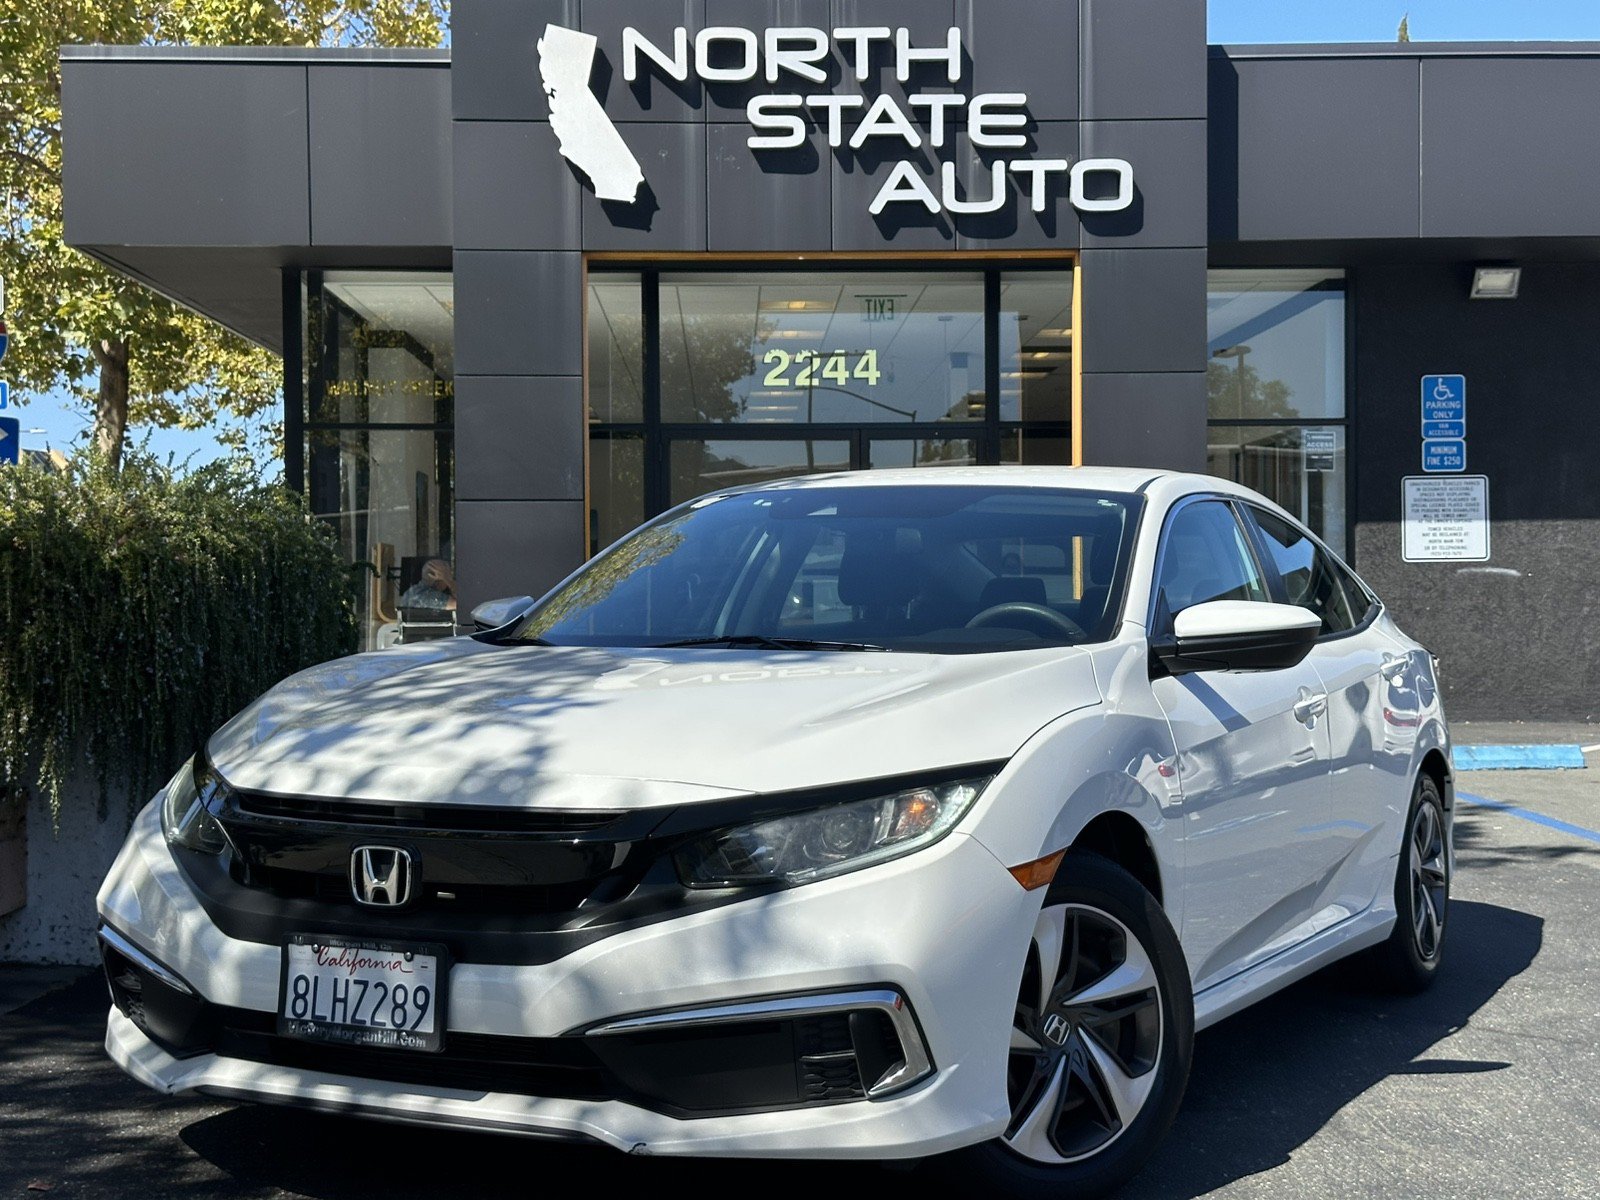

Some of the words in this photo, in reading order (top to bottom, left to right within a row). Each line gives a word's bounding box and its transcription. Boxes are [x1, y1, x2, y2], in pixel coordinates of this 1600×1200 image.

[622, 26, 961, 83] NORTH
[746, 93, 1027, 149] STATE
[868, 159, 1135, 215] AUTO
[763, 349, 881, 386] 2244
[1425, 401, 1461, 409] PARKING
[1432, 411, 1454, 419] ONLY
[1427, 456, 1440, 466] FINE
[1444, 456, 1461, 466] $250
[1430, 446, 1458, 455] MINIMUM
[317, 946, 414, 976] California
[291, 974, 431, 1030] 8LHZ289
[287, 1020, 427, 1048] VicoryMorganHill.com
